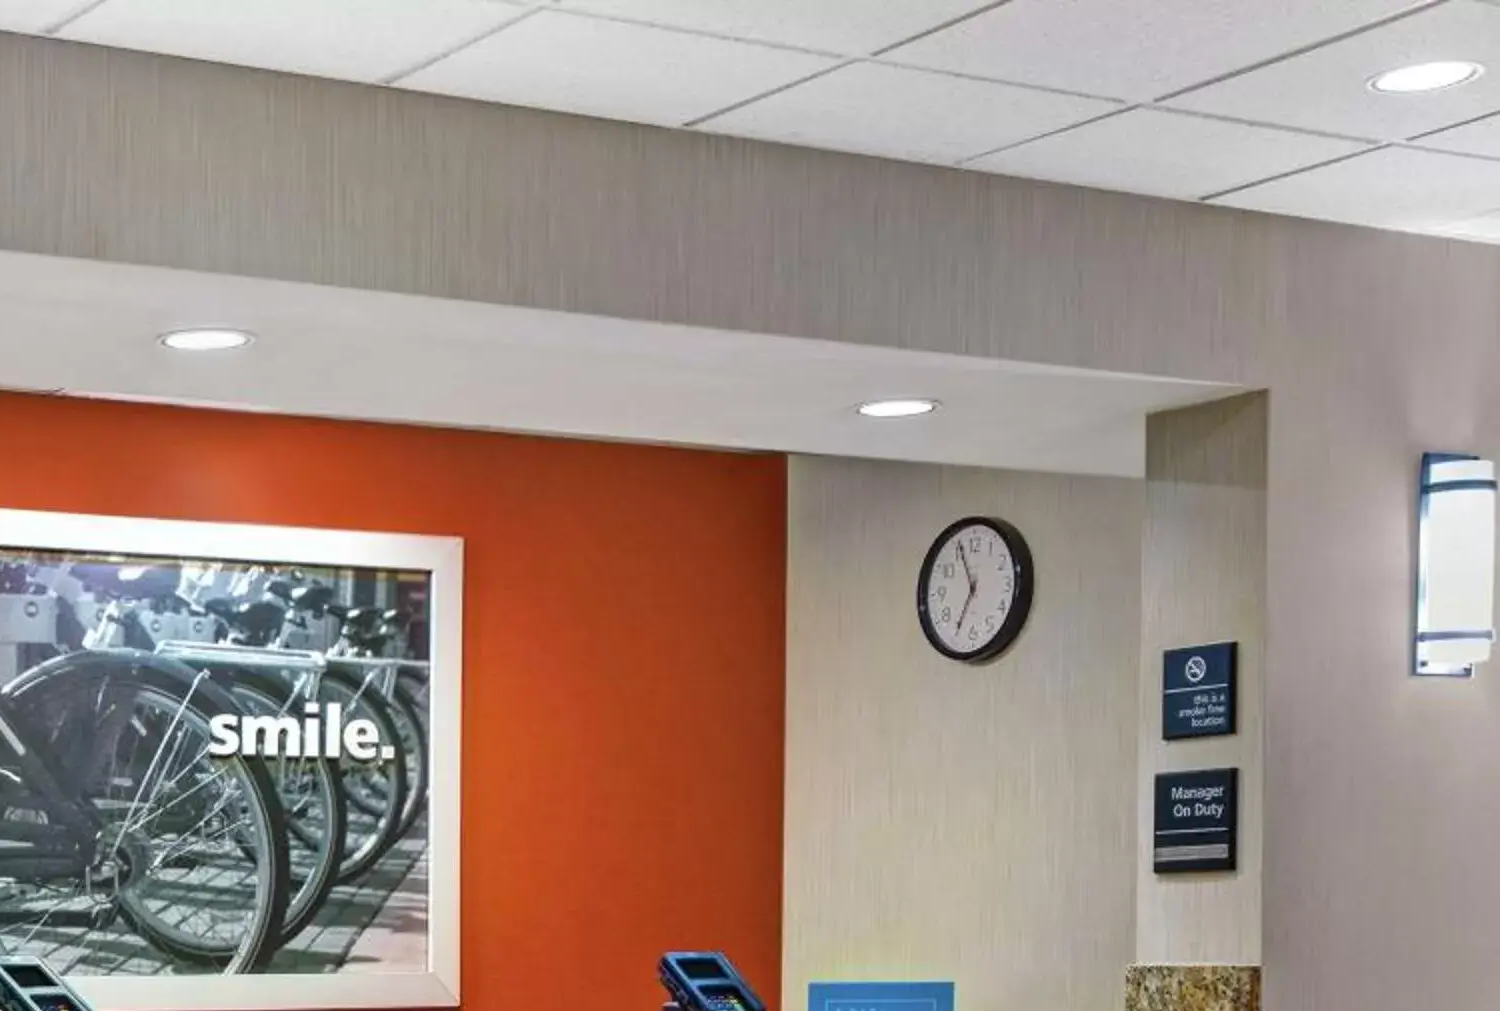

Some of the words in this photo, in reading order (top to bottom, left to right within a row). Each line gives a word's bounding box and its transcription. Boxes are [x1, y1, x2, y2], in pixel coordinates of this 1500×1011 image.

[997, 554, 1007, 571] 2
[209, 702, 395, 760] smile.
[1171, 785, 1225, 801] Manager
[1173, 803, 1192, 817] On
[1194, 802, 1225, 819] Duty
